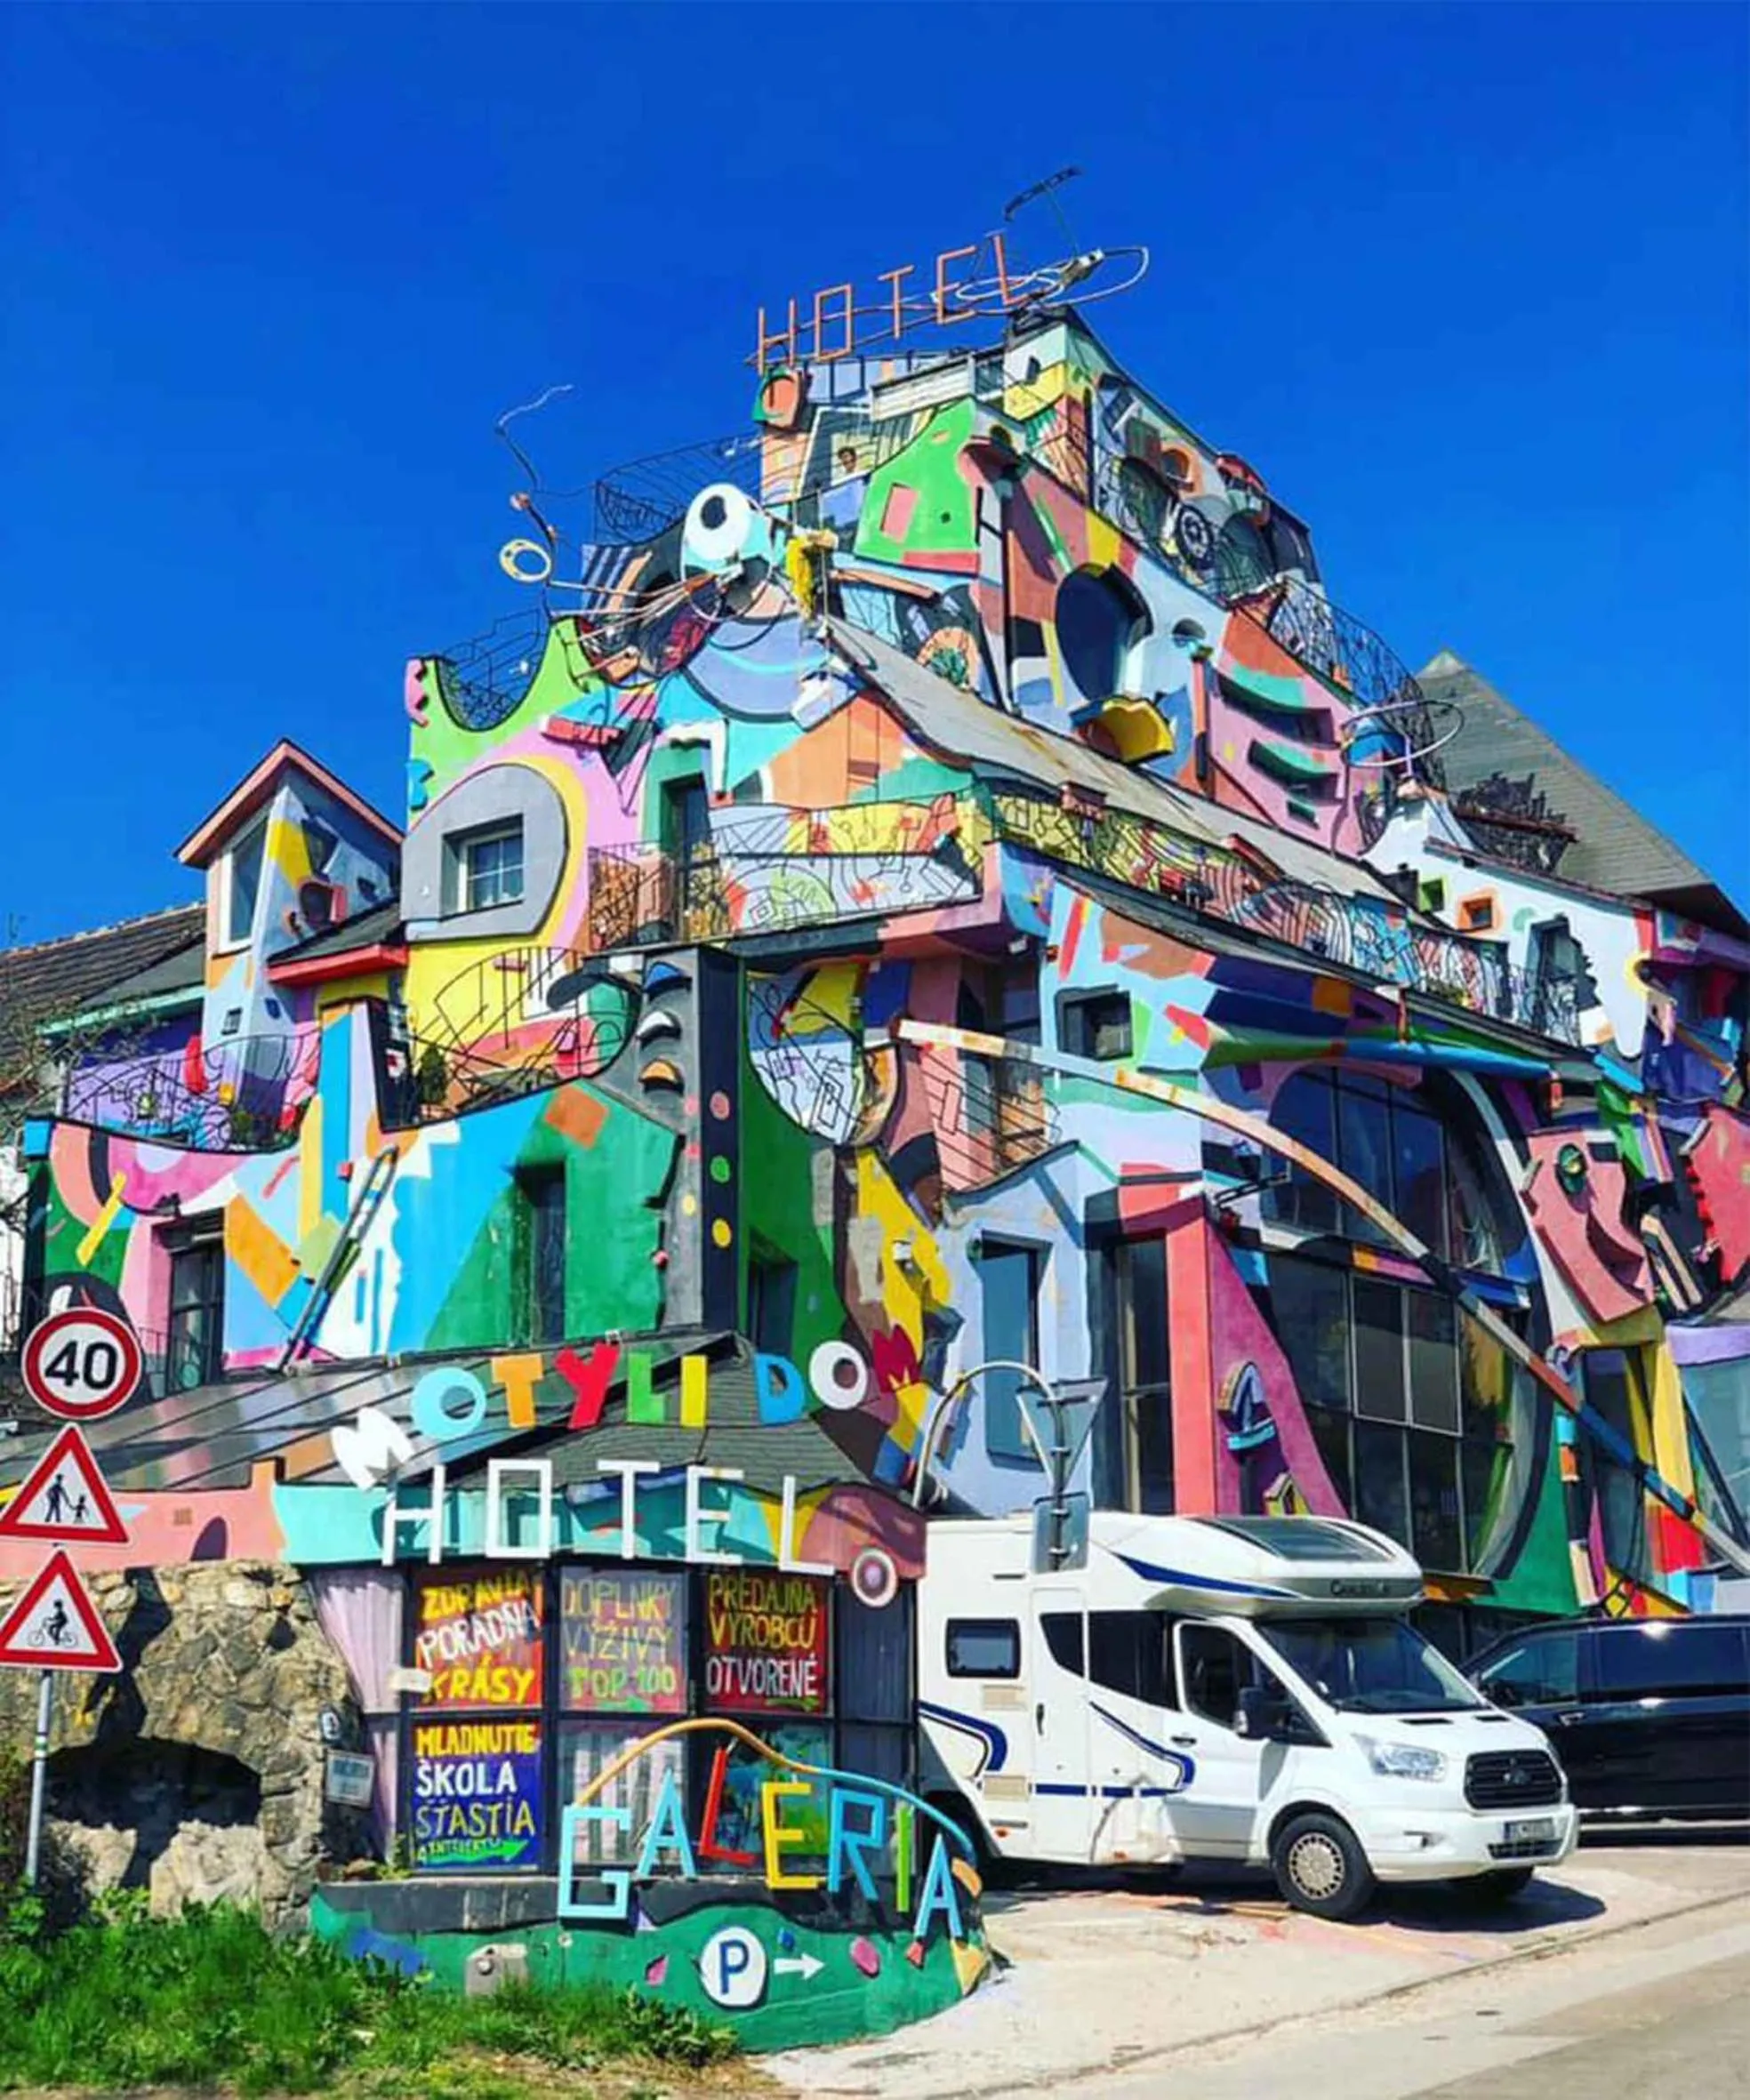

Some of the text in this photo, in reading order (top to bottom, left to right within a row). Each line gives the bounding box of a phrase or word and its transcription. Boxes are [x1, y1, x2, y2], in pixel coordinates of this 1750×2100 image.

[758, 231, 1042, 374] HOTEL
[45, 1340, 118, 1390] 40
[332, 1324, 923, 1489] MOTYLI DOM
[381, 1458, 835, 1576] HOTEL
[706, 1652, 819, 1697] OTVORENÉ
[416, 1759, 518, 1797] ŠKOLA
[558, 1748, 963, 1938] GALERIA
[718, 1940, 749, 1994] P
